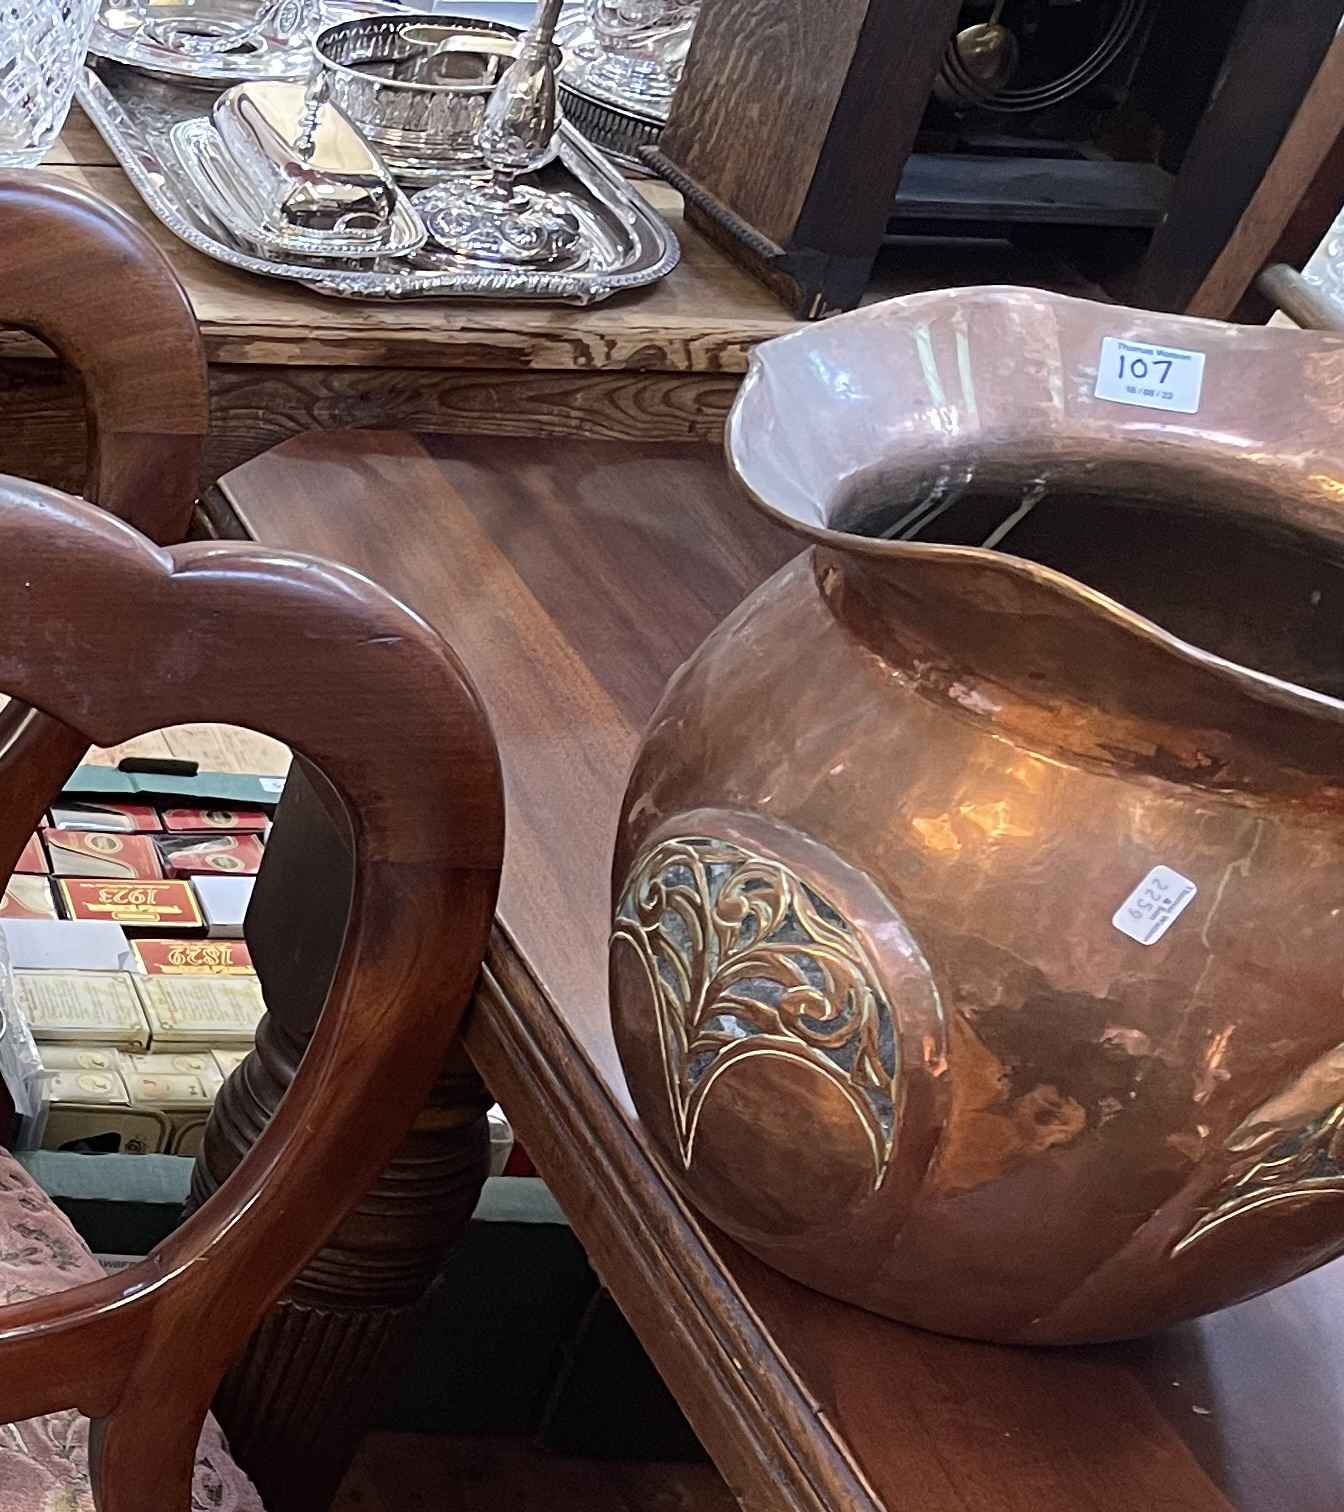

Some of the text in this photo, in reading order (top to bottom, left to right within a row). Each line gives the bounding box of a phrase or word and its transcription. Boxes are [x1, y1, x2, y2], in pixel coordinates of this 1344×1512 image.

[1118, 355, 1173, 384] 107
[98, 887, 157, 905] 1923
[168, 945, 233, 965] 1829
